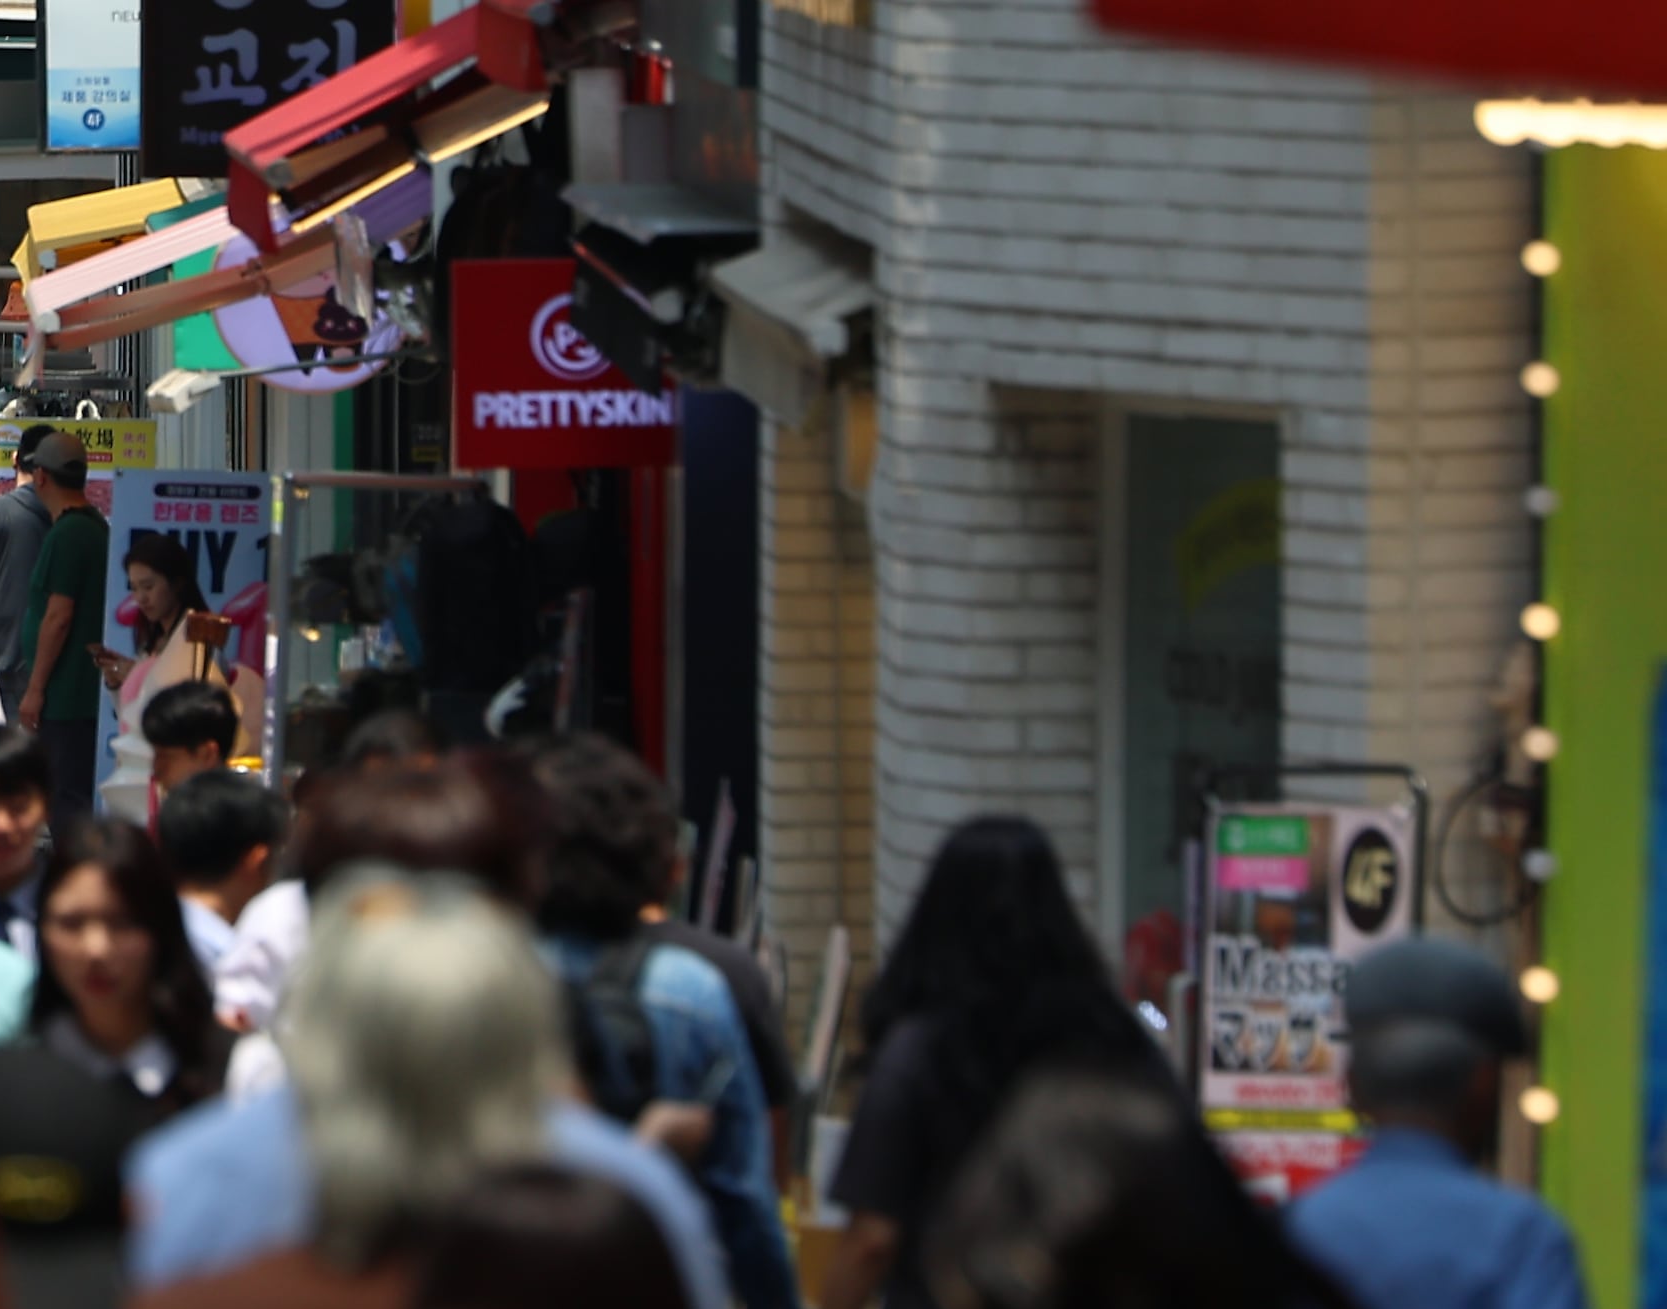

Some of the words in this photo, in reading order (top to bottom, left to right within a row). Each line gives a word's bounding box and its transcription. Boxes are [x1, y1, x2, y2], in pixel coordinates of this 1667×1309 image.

[87, 112, 101, 126] 4F
[472, 389, 675, 430] PRETTYSKIN
[1212, 942, 1351, 999] Massa
